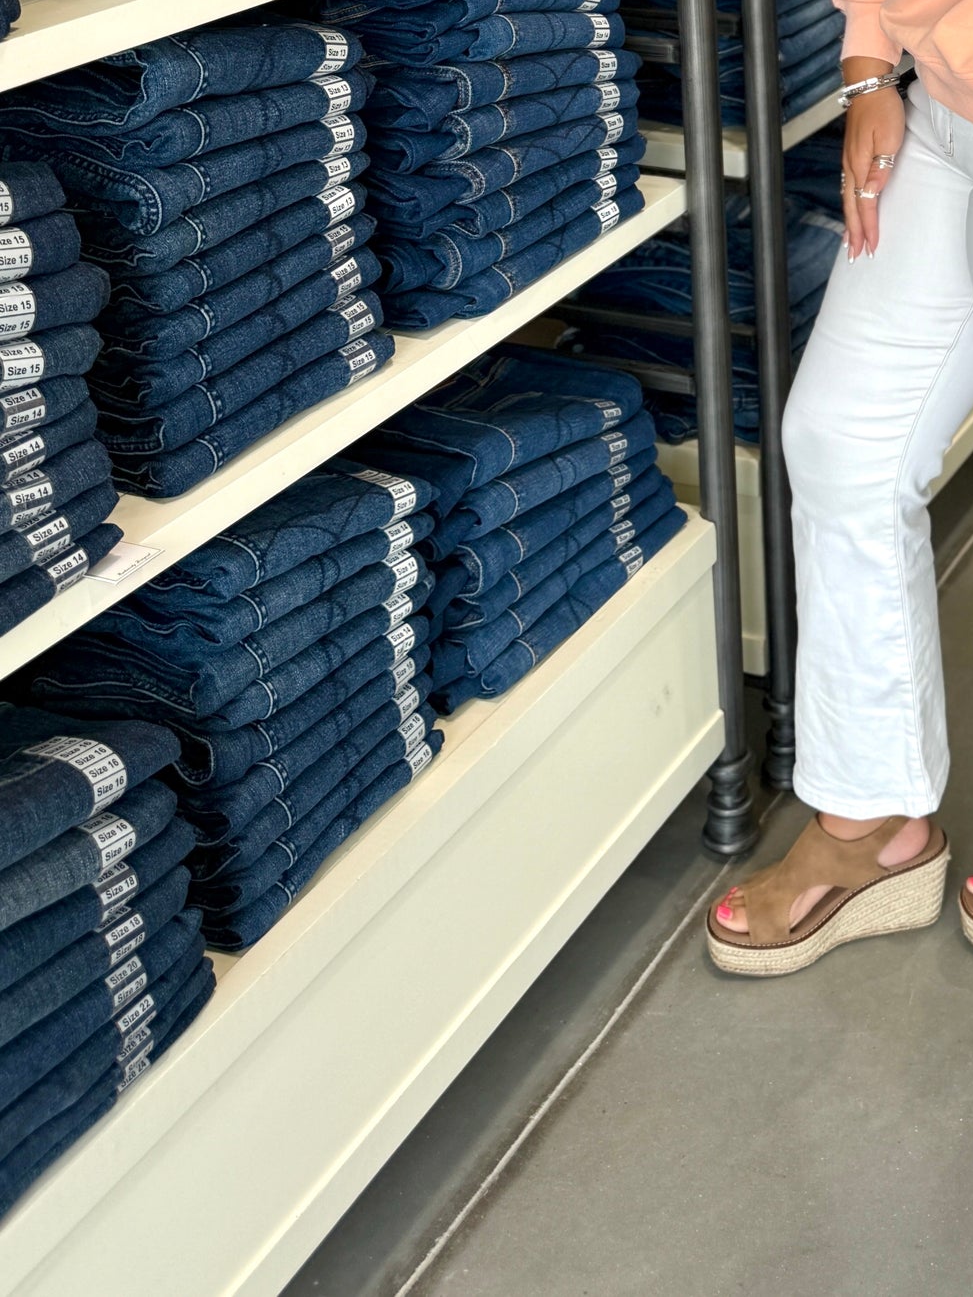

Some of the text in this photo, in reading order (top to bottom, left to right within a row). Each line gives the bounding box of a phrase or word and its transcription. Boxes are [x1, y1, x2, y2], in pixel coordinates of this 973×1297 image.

[328, 86, 340, 95] Size
[329, 164, 341, 173] Size
[332, 197, 352, 214] Size 13
[601, 210, 610, 219] Size
[0, 254, 28, 265] Size 15
[335, 262, 355, 278] Size 15
[0, 301, 31, 312] Size 15
[0, 321, 30, 332] Size 15
[352, 316, 372, 332] Size 15
[352, 352, 373, 368] Size 15
[8, 364, 40, 376] Size 15
[5, 390, 37, 406] Size 14
[11, 409, 42, 425] Size 14
[9, 440, 41, 462] Size 14
[15, 487, 48, 504] Size 14
[392, 487, 404, 495] Size
[33, 520, 65, 542] Size 14
[388, 524, 408, 537] Size 14
[53, 554, 84, 575] Size 14
[396, 566, 408, 575] Size
[391, 627, 411, 642] Size 14
[402, 716, 420, 734] Size 16
[75, 745, 107, 766] Size 16
[413, 749, 430, 769] Size 16
[89, 758, 119, 778] Size 16
[97, 775, 124, 797] Size 16
[98, 822, 127, 843] Size 16
[106, 876, 135, 899] Size 18
[111, 916, 140, 941] Size 18
[110, 961, 138, 985] Size 20
[117, 978, 144, 1003] Size 20
[122, 999, 150, 1027] Size 22
[120, 1030, 147, 1058] Size 24
